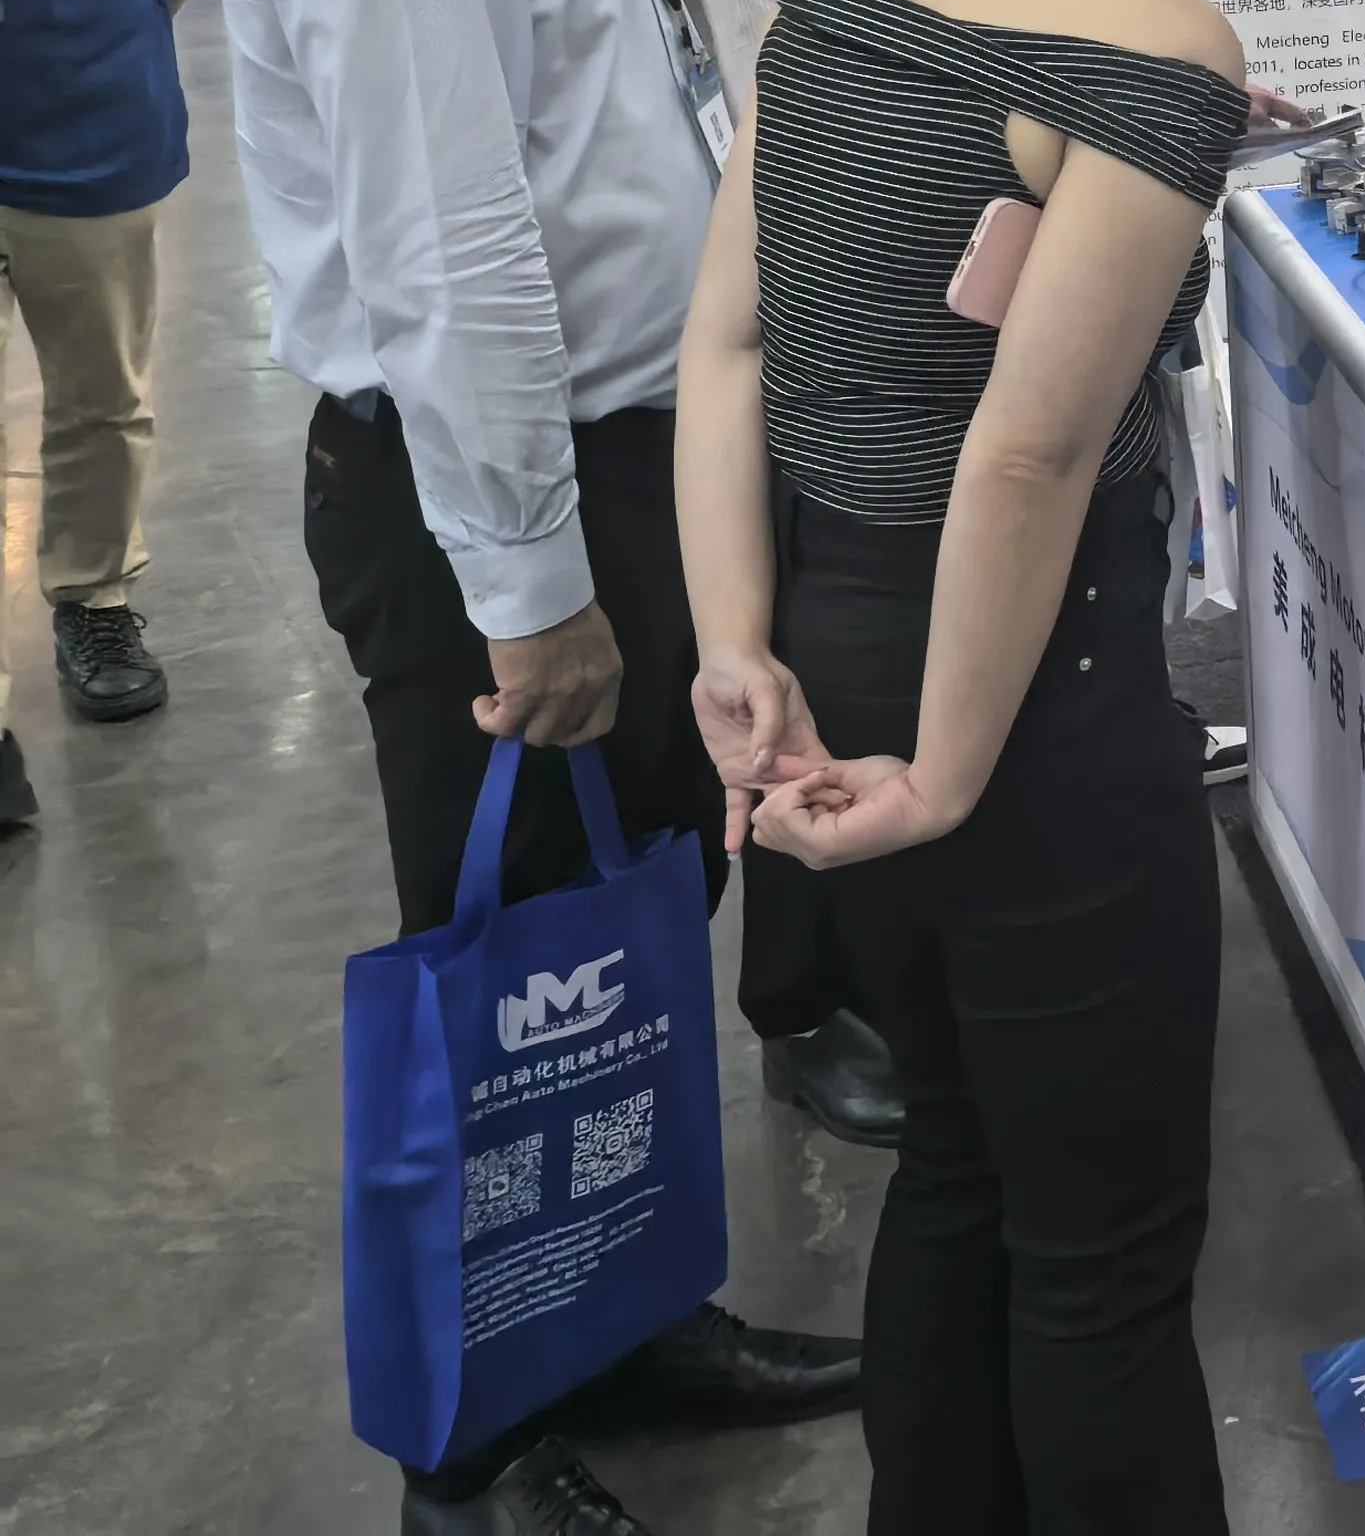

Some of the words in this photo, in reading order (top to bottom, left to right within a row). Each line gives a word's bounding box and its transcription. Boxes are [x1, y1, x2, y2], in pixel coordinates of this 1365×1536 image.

[1256, 34, 1329, 49] Meicheng
[1294, 56, 1342, 70] locates
[1348, 54, 1360, 66] in
[1275, 84, 1285, 96] is
[1269, 466, 1328, 603] Meicheng
